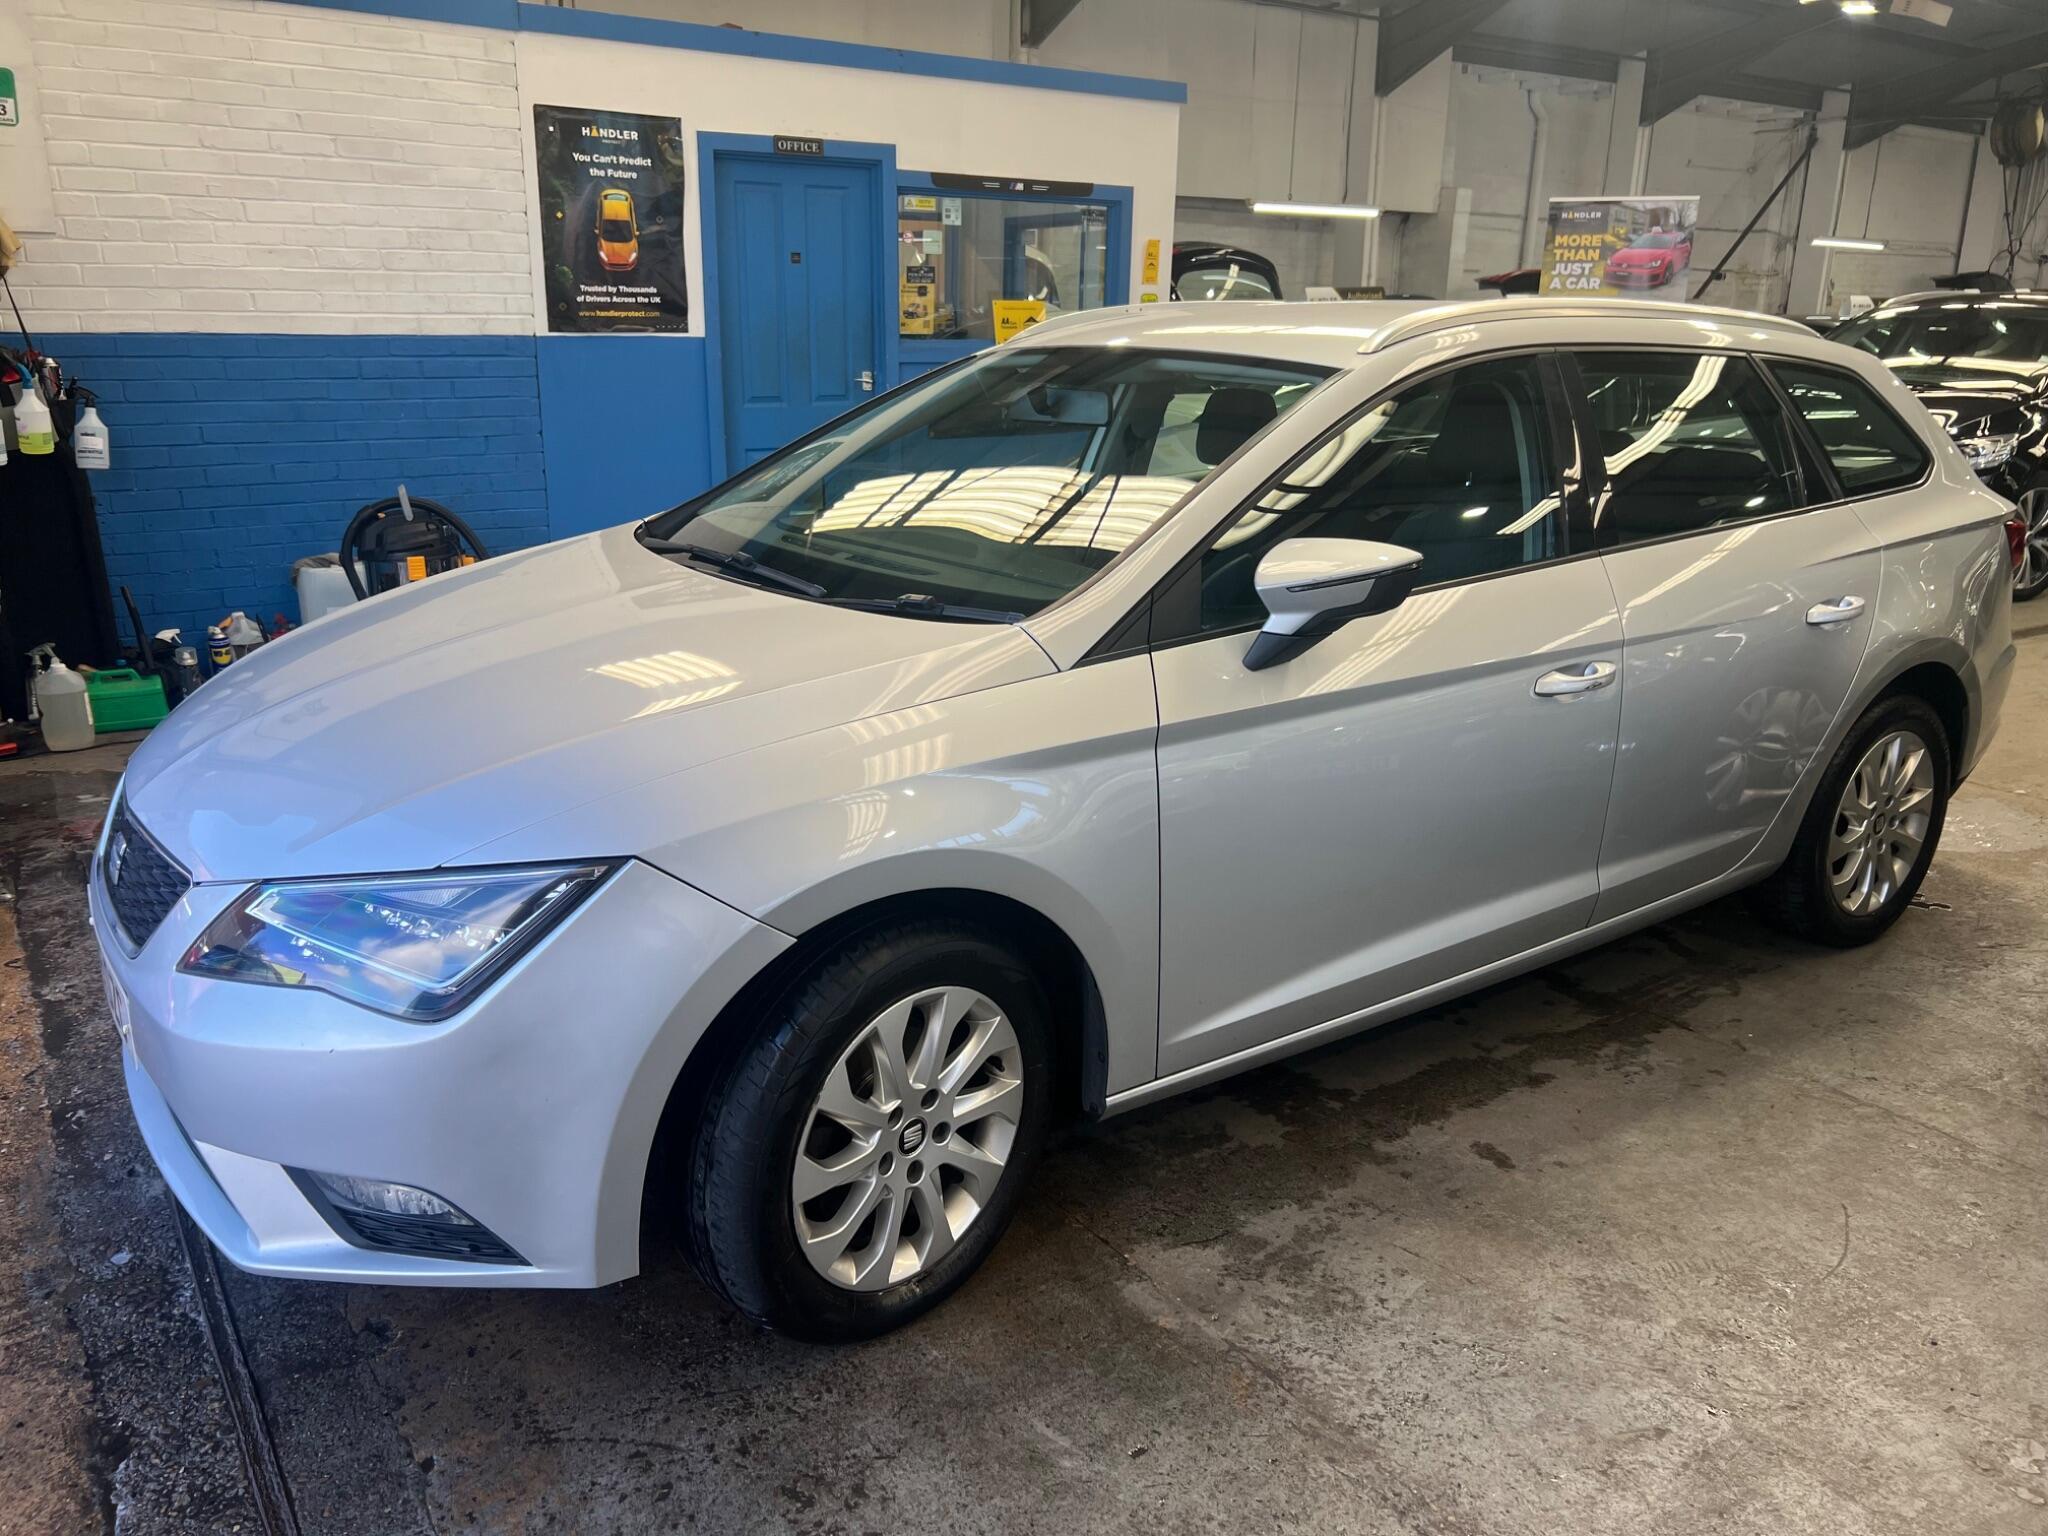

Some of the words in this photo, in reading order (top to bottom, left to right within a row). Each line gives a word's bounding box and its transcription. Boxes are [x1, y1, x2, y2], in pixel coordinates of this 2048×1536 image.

[778, 140, 820, 152] OFFICE
[573, 153, 591, 162] You
[592, 154, 617, 164] Can't
[619, 156, 652, 166] Predict
[589, 168, 606, 177] the
[607, 169, 638, 179] Future
[1554, 234, 1602, 247] MORE
[1553, 249, 1600, 261] THAN
[1551, 262, 1593, 275] JUST
[1549, 277, 1561, 289] A
[1565, 277, 1600, 289] CAR
[608, 286, 617, 294] by
[618, 285, 657, 293] Thousands
[578, 310, 660, 318] www.handlerprotect.com
